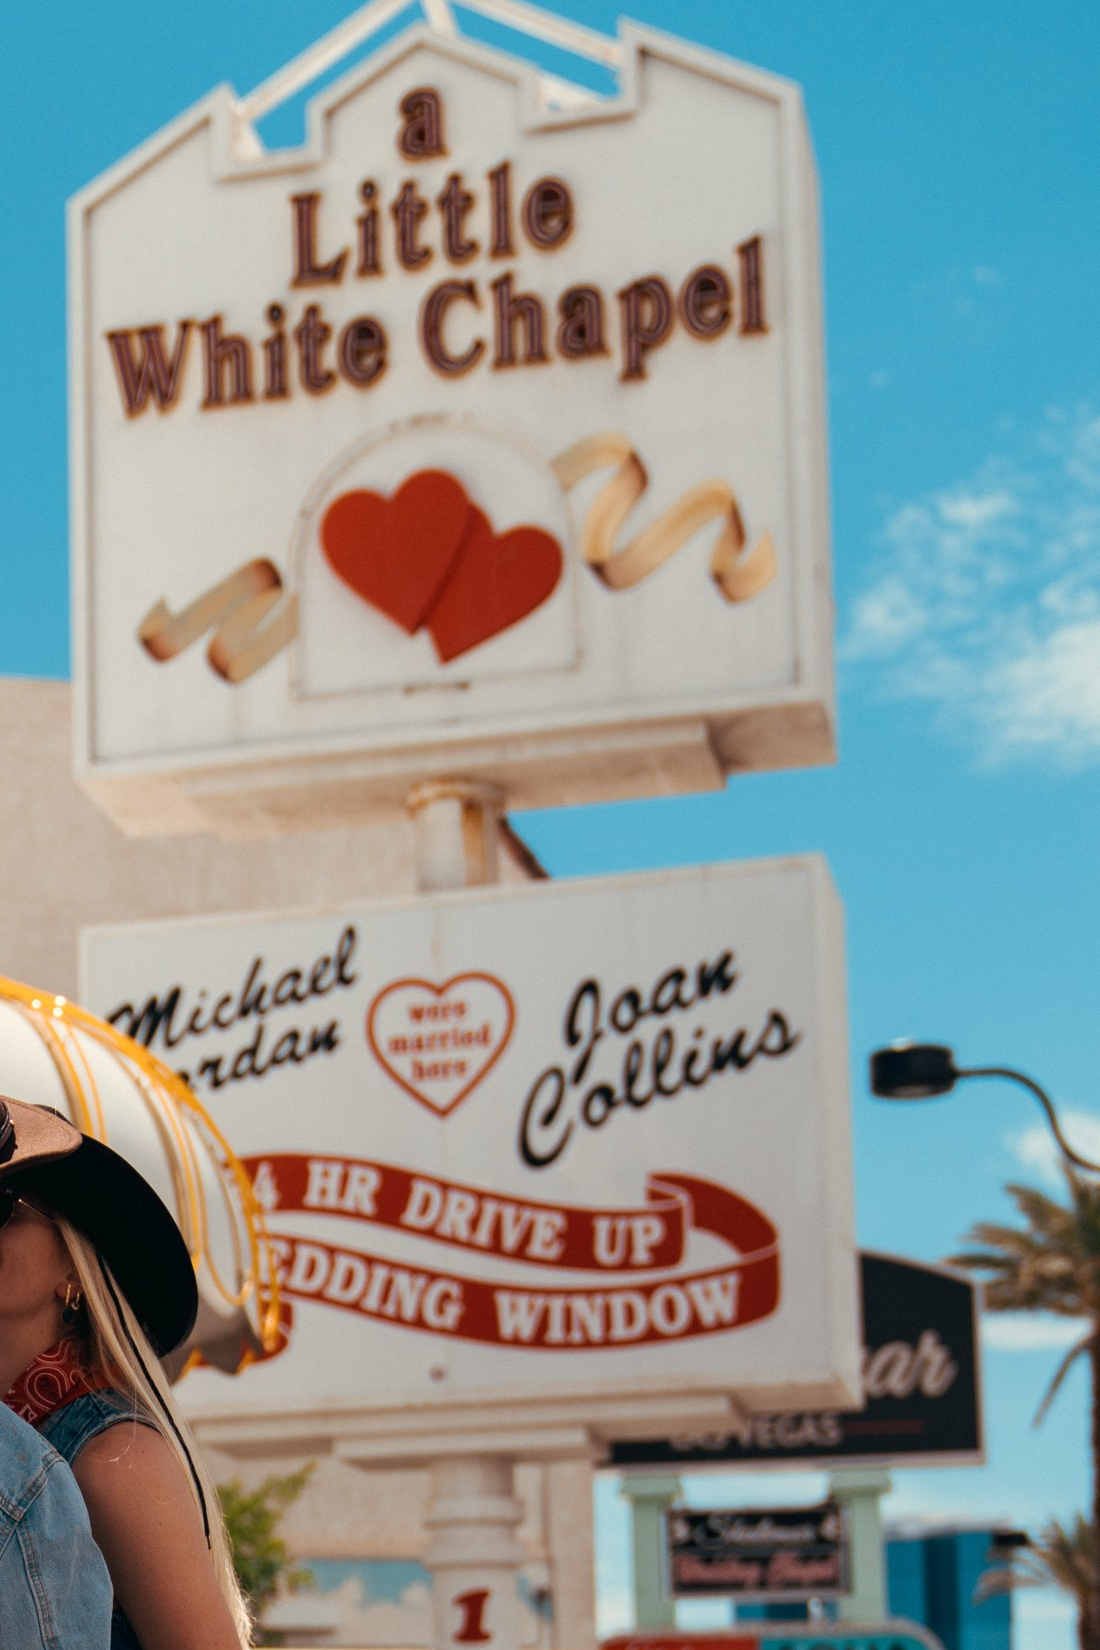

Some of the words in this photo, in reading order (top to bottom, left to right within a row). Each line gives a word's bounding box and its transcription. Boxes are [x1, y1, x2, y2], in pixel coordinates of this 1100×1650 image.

[398, 85, 447, 162] a
[290, 161, 575, 290] Little
[106, 301, 389, 421] White
[420, 235, 770, 384] Chapel
[105, 923, 359, 1048] Michael
[387, 1022, 492, 1054] married
[409, 1001, 467, 1023] were
[564, 950, 741, 1086] Joan
[411, 1057, 469, 1081] here
[517, 1009, 803, 1168] Collins
[303, 1159, 382, 1216] HR
[400, 1178, 566, 1264] DRIVE
[592, 1215, 668, 1267] UP
[257, 1236, 465, 1330] EDDING
[494, 1274, 743, 1345] WINDOW
[862, 1328, 958, 1399] ar
